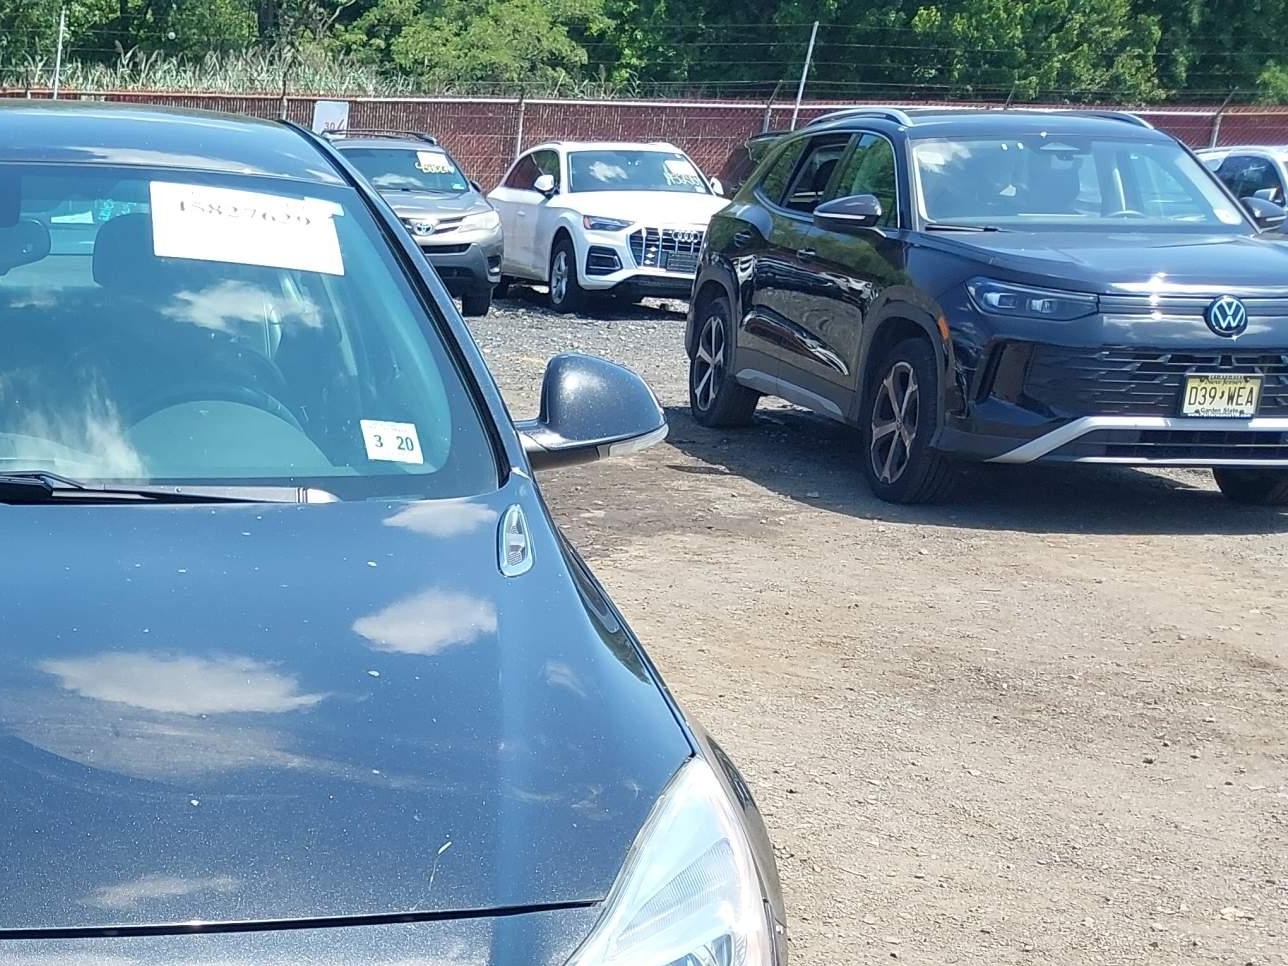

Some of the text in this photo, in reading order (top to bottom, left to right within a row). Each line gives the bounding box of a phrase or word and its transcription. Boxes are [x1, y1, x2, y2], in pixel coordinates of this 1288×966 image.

[1187, 386, 1254, 406] D39 WEA
[372, 434, 415, 452] 3 20
